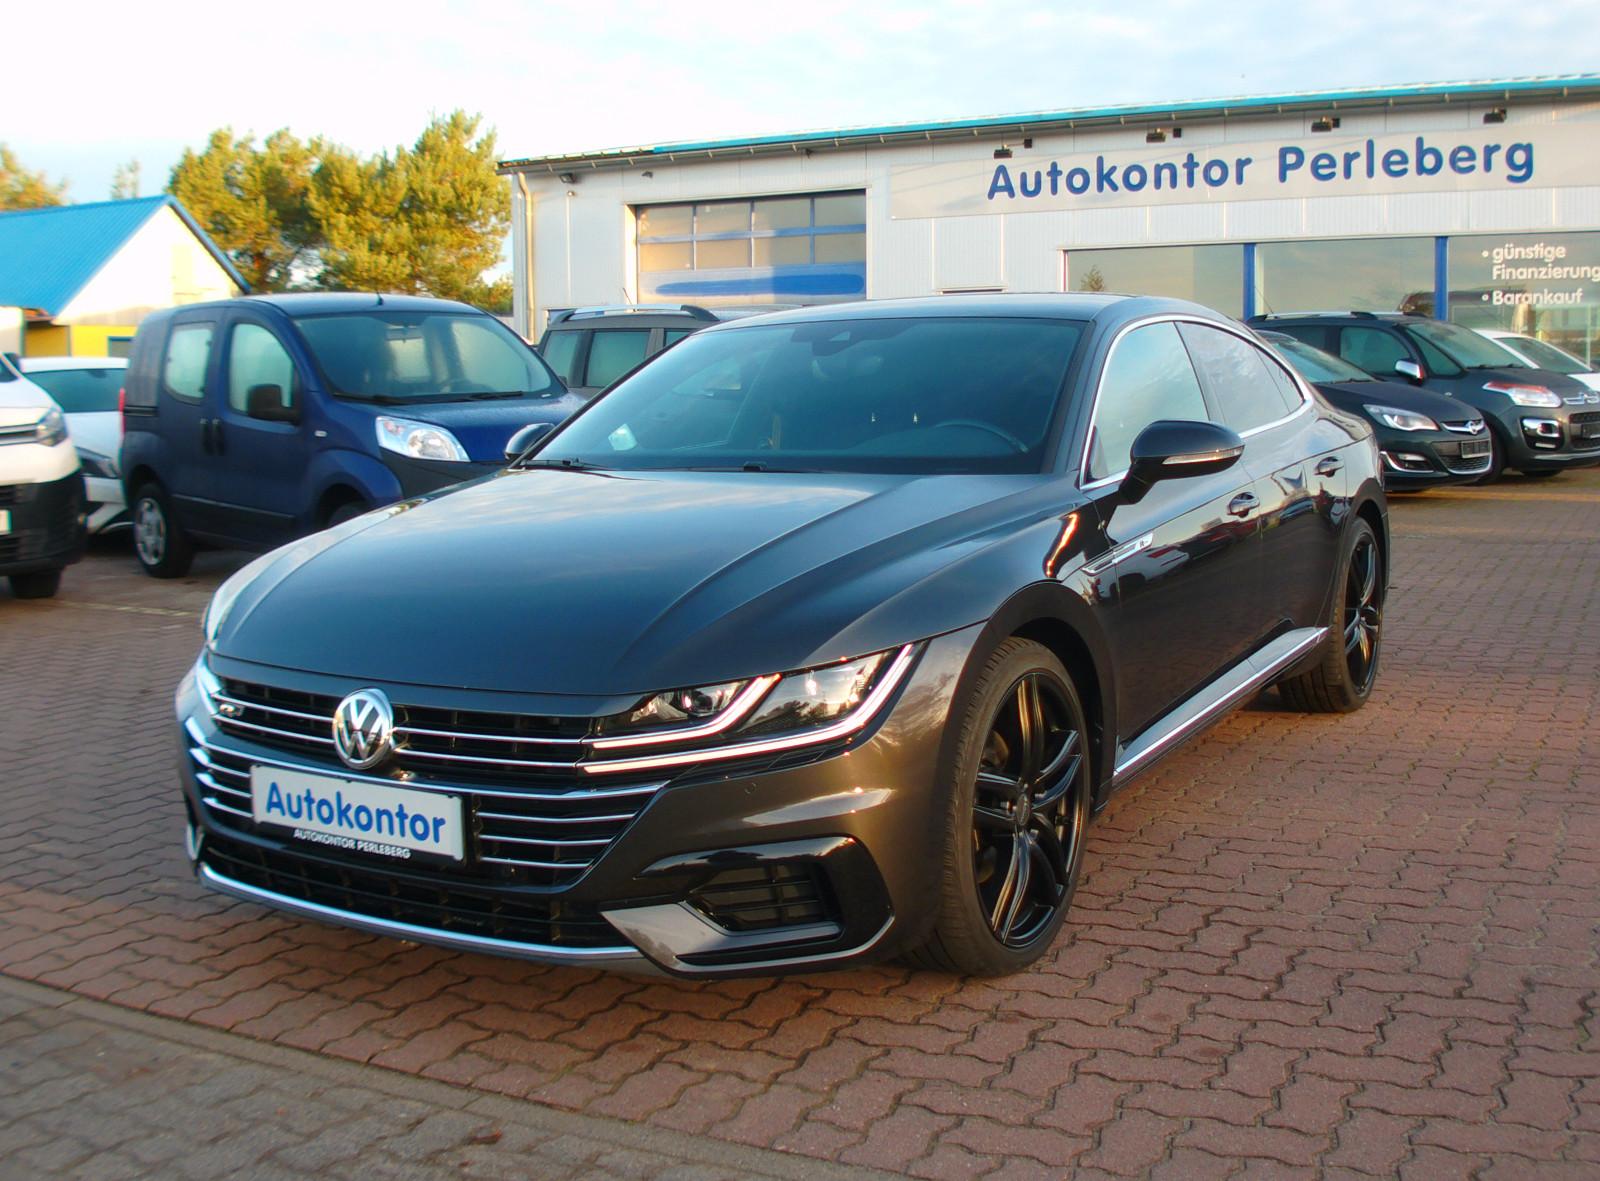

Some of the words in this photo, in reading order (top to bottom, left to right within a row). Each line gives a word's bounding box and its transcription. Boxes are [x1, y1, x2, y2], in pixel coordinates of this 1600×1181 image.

[987, 154, 1252, 200] Autokontor
[1278, 136, 1534, 184] Perleberg
[1492, 243, 1566, 263] günstige
[1492, 263, 1600, 282] Finanzierung
[1492, 288, 1583, 305] Barankauf
[266, 781, 446, 844] Autokontor
[293, 829, 356, 849] AUTOKONTOR
[357, 841, 412, 859] PERLEBERG
